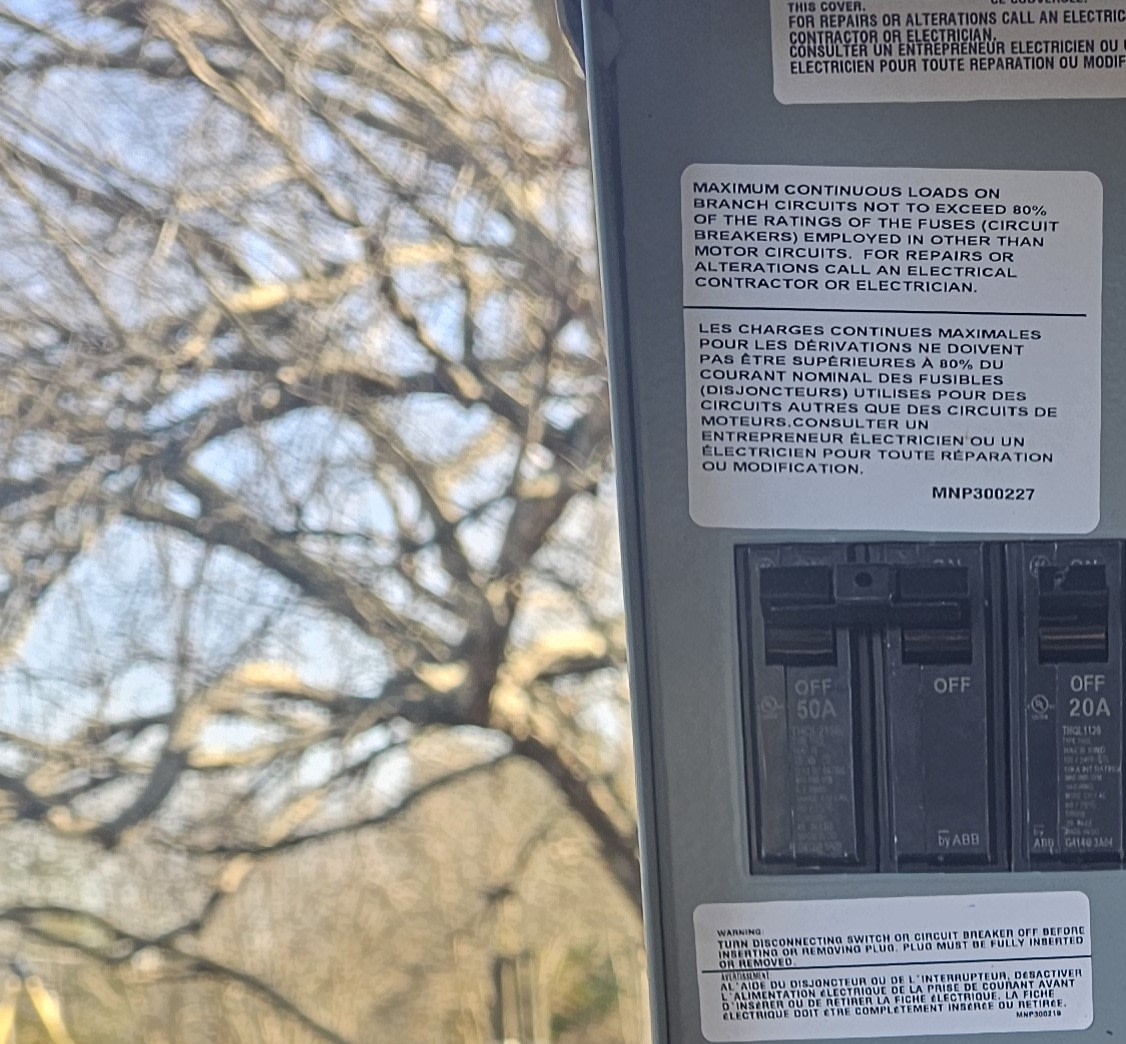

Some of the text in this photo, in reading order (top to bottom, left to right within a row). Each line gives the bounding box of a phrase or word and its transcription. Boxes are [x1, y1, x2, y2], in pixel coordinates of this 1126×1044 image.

[787, 1, 865, 12] THIS COVER.
[788, 8, 1126, 28] FOR REPAIRS OR ALTERATIONS CALL AN ELECTRIC
[789, 27, 996, 44] CONTRACTOR OR ELECTRICIAN.
[789, 42, 867, 57] CONSULTER
[873, 43, 892, 56] UN
[898, 40, 1005, 56] ENTREPRENEUR
[1010, 39, 1094, 54] ELECTRICIEN
[1099, 39, 1118, 52] OU
[790, 59, 874, 74] ELECTRICIEN
[879, 58, 916, 72] POUR
[922, 57, 964, 71] TOUTE
[969, 56, 1054, 71] REPARATION
[1059, 55, 1077, 69] OU
[693, 181, 999, 199] MAXIMUM CONTINUOUS LOADS ON
[693, 197, 1046, 216] BRANCH CIRCUITS NOT TO EXCEED 80%
[693, 213, 1059, 233] OF THE RATINGS OF THE FUSES (CIRCUIT
[694, 229, 1043, 247] BREAKERS) EMPLOYED IN OTHER THAN
[694, 245, 1013, 262] MOTOR CIRCUITS. FOR REPAIRS OR
[694, 261, 1017, 277] ALTERATIONS CALL AN ELECTRICAL
[694, 276, 976, 292] CONTRACTOR OR ELECTRICIAN.
[698, 322, 1041, 340] LES CHARGES CONTINUES MAXIMALES
[699, 338, 1024, 355] POUR LES DÉRIVATIONS NE DOIVENT
[699, 352, 1003, 369] PAS ÊTRE SUPÉRIEURES À 80% DU
[699, 368, 1003, 385] COURANT NOMINAL DES FUSIBLES
[700, 384, 1026, 401] (DISJONCTEURS) UTILISES POUR DES
[700, 399, 1056, 417] CIRCUITS AUTRES QUE DES CIRCUITS DE
[905, 419, 928, 430] UN
[701, 430, 1024, 447] ENTREPRENEUR ÉLECTRICIEN OU UN
[702, 444, 1052, 462] ÉLECTRICIEN POUR TOUTE RÉPARATION
[701, 460, 863, 474] OU MODIFICATION.
[932, 486, 1034, 500] MNP300227
[795, 679, 832, 695] OFF
[934, 677, 971, 693] OFF
[1070, 675, 1105, 692] OFF
[796, 702, 837, 719] 50A
[1069, 697, 1111, 717] 20A
[952, 833, 979, 846] ABB
